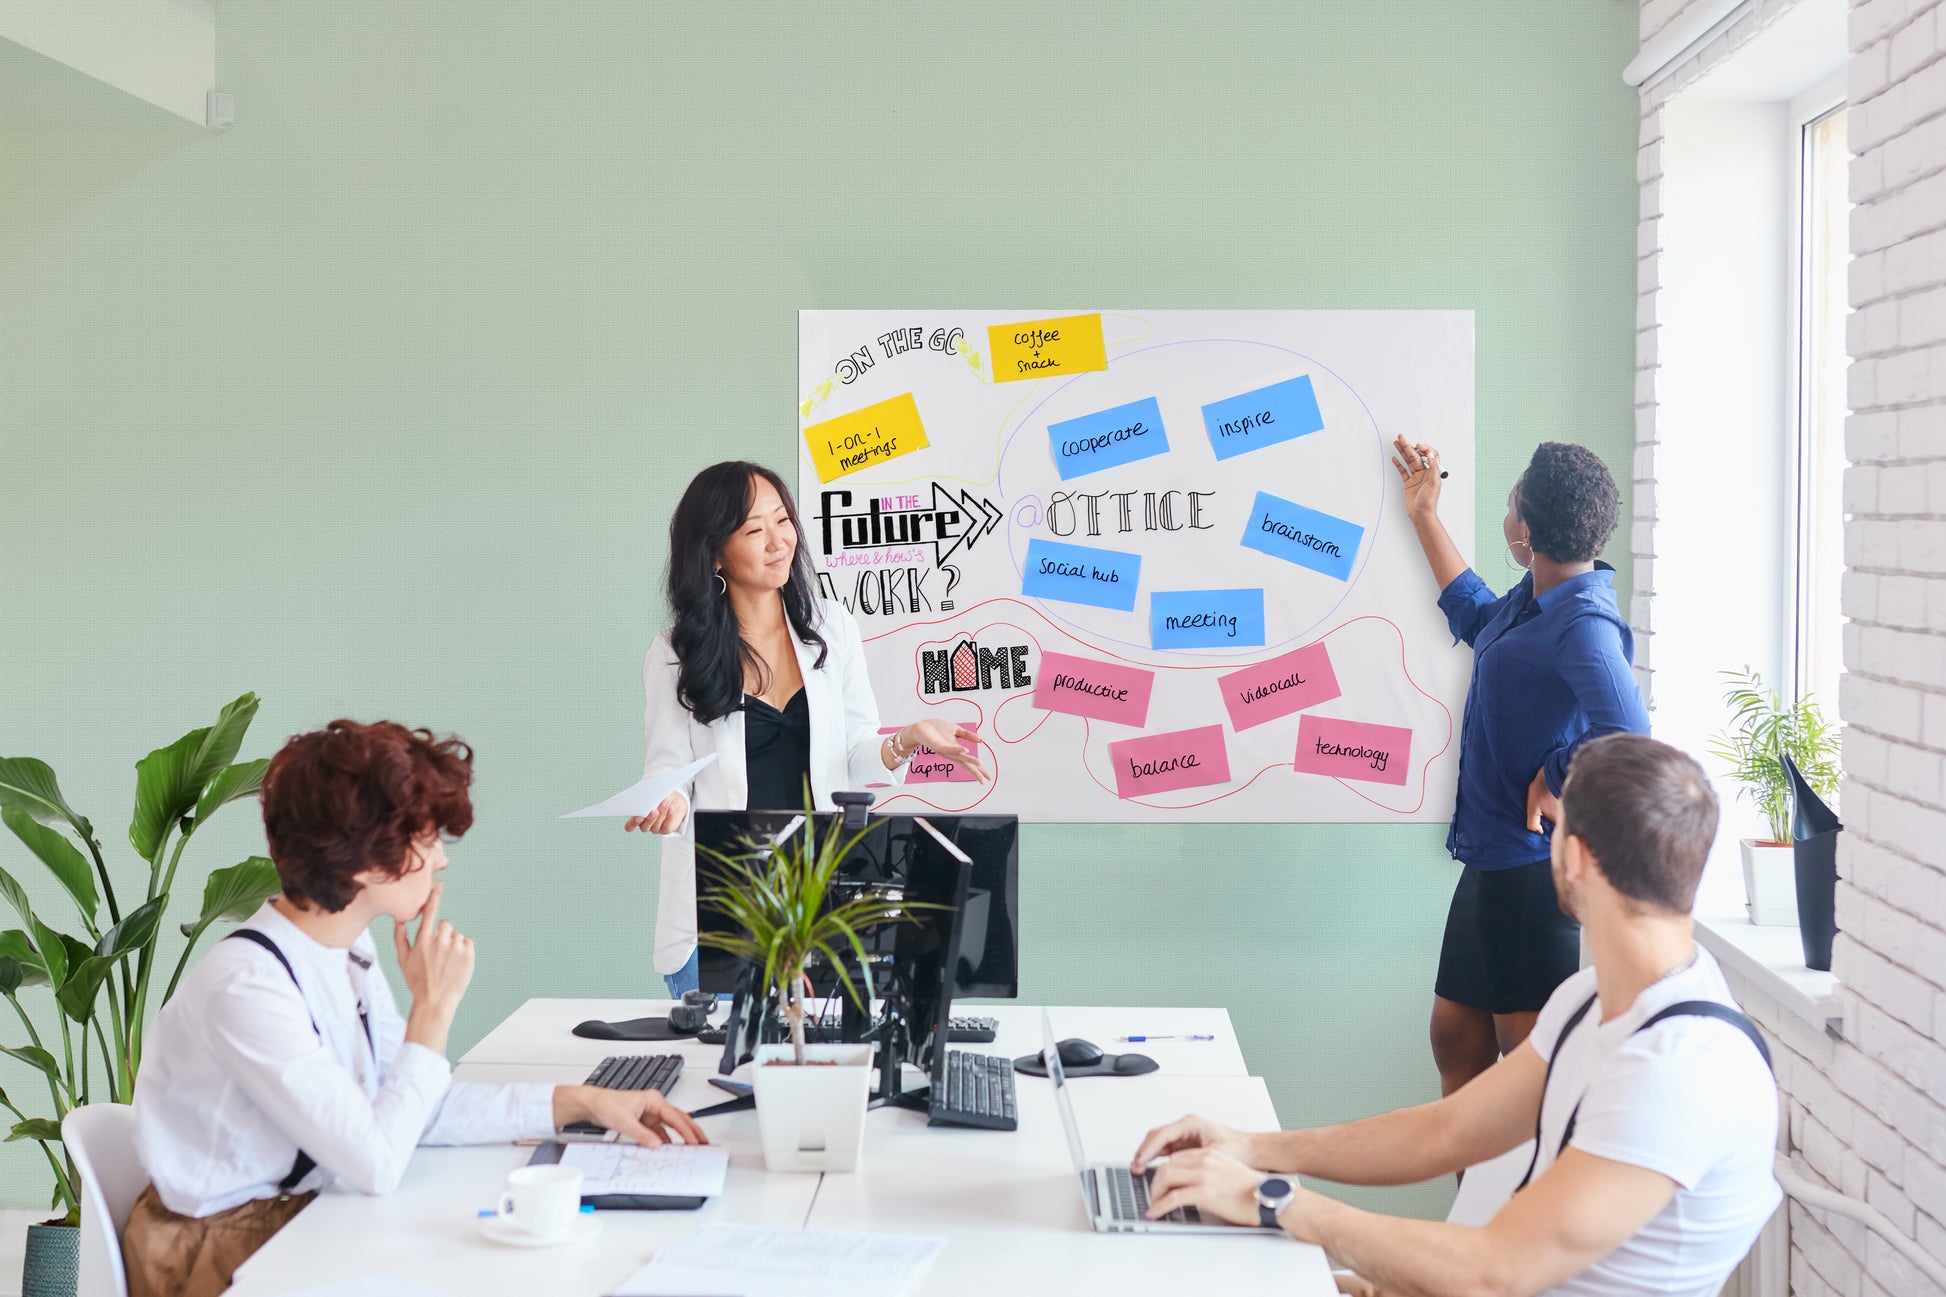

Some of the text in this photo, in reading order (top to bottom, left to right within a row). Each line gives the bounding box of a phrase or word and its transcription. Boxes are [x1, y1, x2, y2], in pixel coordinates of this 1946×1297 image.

[1014, 329, 1061, 349] coffee
[834, 345, 876, 385] ON
[877, 326, 923, 359] THE
[1218, 410, 1276, 438] inspire
[1061, 422, 1149, 458] cooperate
[839, 437, 898, 472] meetings
[880, 494, 922, 512] IN THE
[1261, 513, 1341, 559] brainstorm
[825, 552, 869, 569] where
[1091, 565, 1120, 584] hub
[1166, 614, 1237, 638] meeting
[1053, 672, 1129, 703] productive
[1130, 753, 1201, 779] balance
[1315, 736, 1390, 772] technology
[909, 760, 955, 778] laptop
